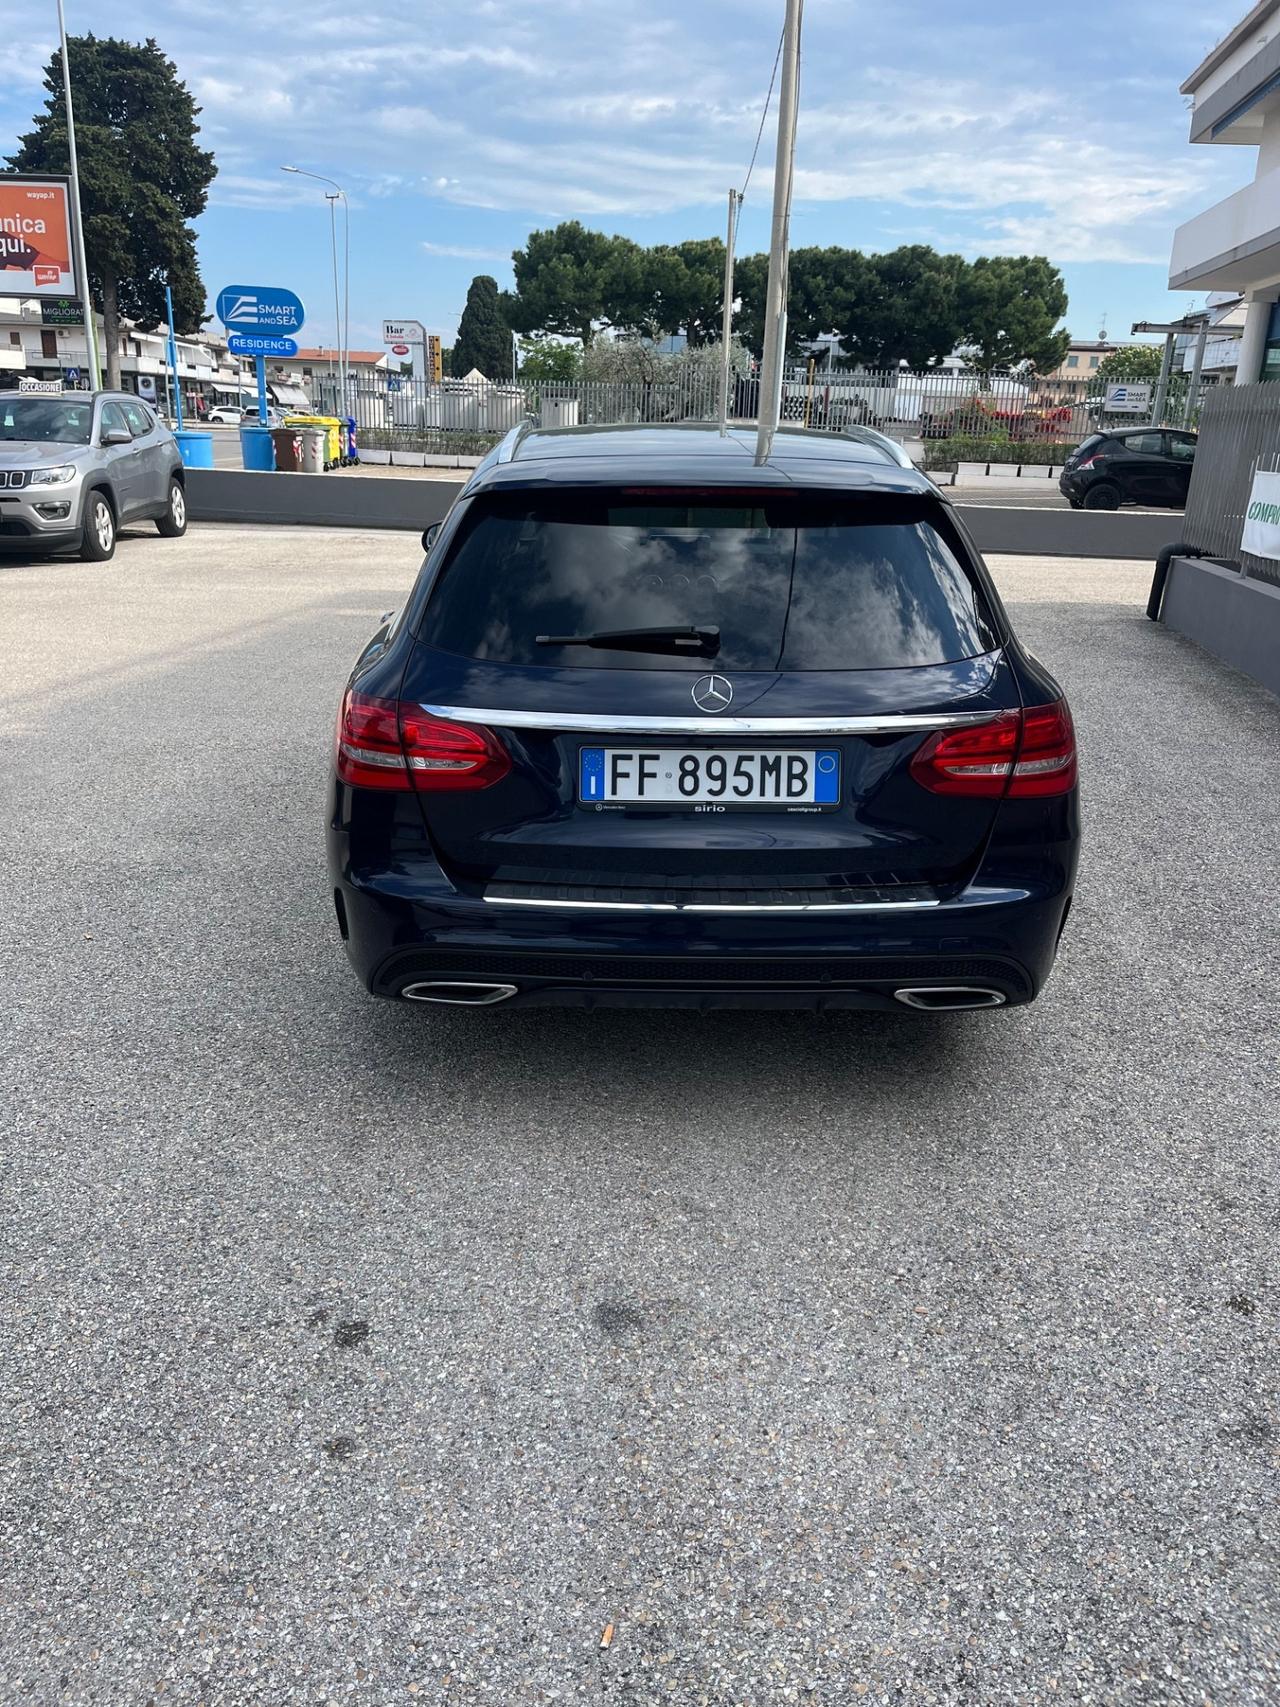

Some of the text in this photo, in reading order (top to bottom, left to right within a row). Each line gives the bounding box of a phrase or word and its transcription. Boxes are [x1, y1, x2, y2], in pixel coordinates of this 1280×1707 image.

[26, 191, 55, 199] wayap.it
[0, 233, 31, 257] qui.
[258, 304, 296, 315] SMART
[386, 325, 405, 334] Bar
[232, 338, 292, 350] RESIDENCE
[21, 383, 60, 392] OCCASIONE
[611, 754, 809, 798] FF 895MB
[694, 804, 726, 813] sirio
